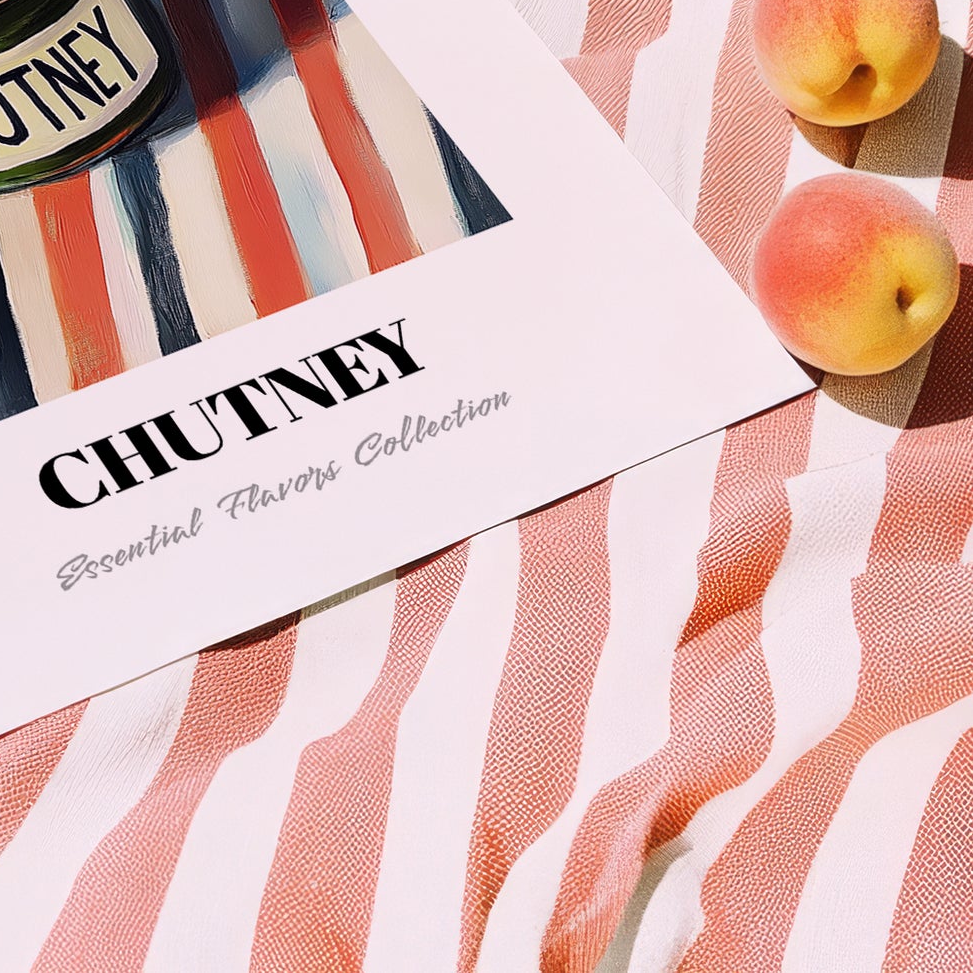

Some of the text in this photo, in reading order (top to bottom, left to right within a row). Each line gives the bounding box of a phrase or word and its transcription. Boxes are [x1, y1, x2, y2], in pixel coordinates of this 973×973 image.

[38, 318, 426, 510] CHUTNEY
[55, 390, 512, 592] Essential Flavors Collection
